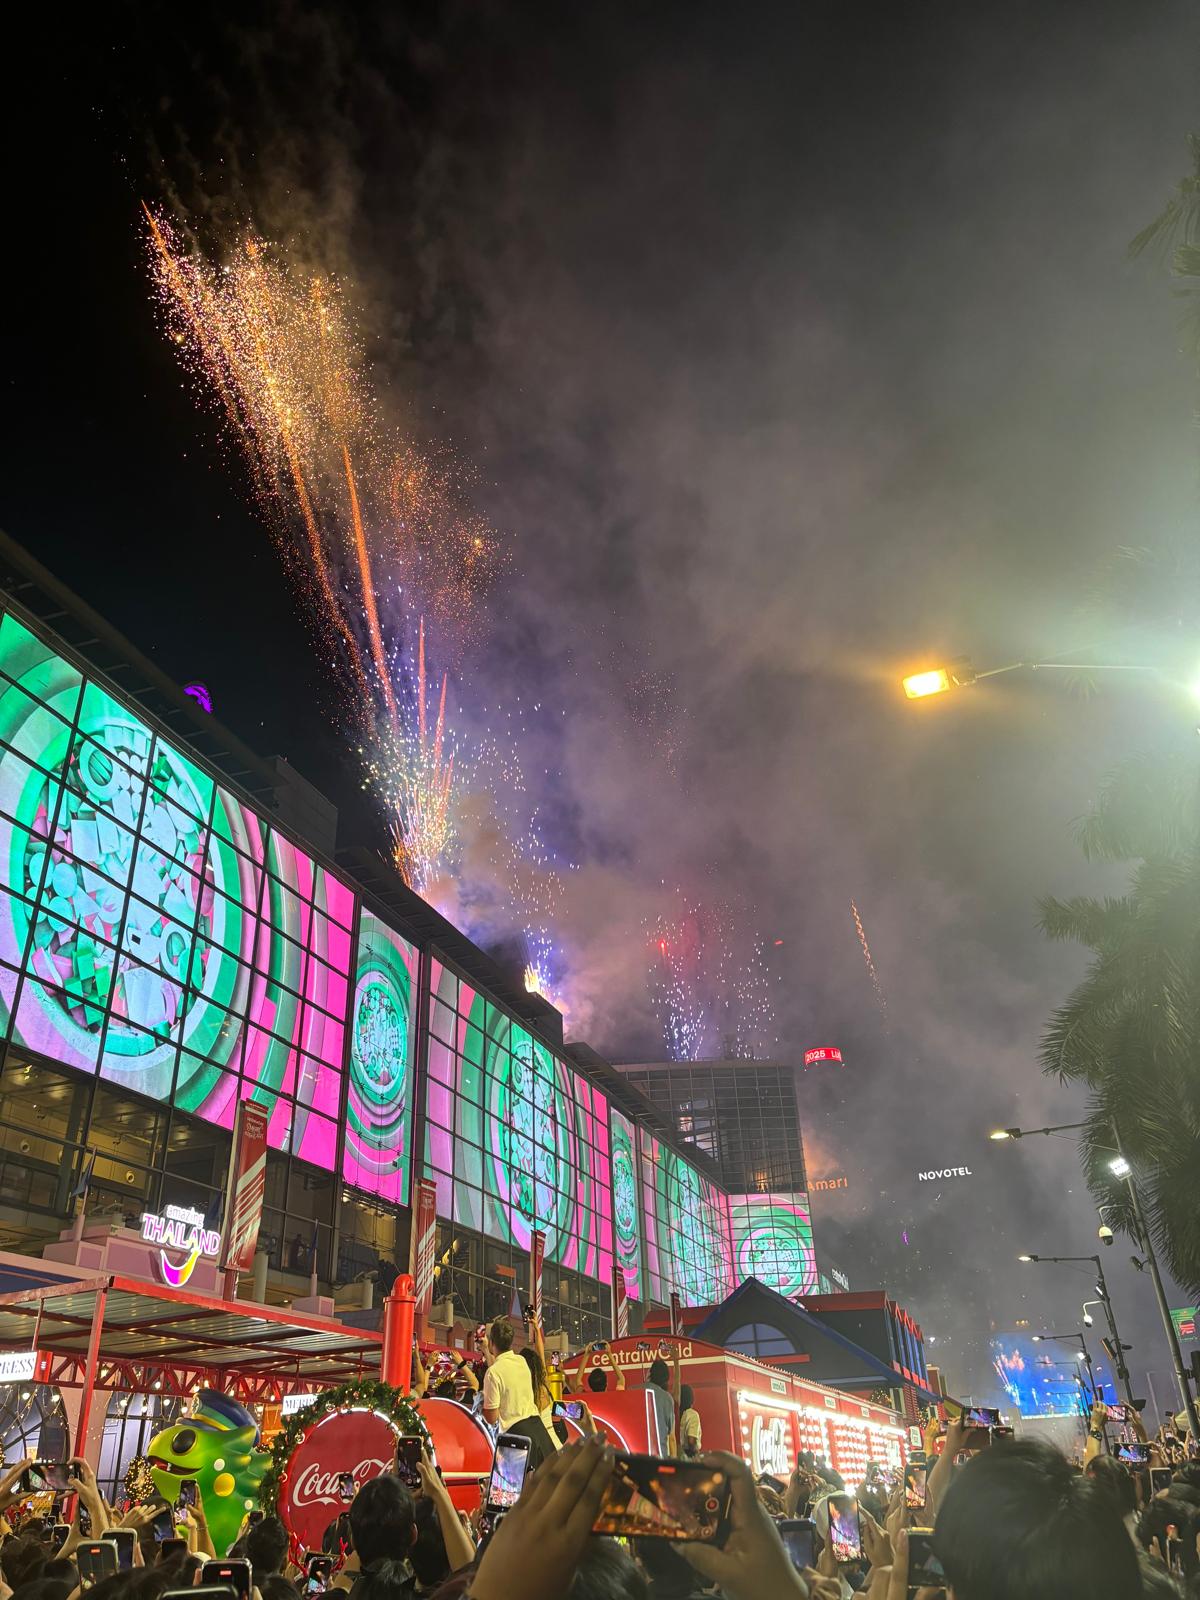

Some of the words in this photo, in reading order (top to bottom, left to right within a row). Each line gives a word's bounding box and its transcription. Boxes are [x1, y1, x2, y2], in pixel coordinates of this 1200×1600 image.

[806, 1050, 826, 1062] 2025
[918, 1166, 972, 1181] NOVOTEL
[167, 1204, 204, 1229] amazing
[143, 1213, 221, 1255] THAILAND
[0, 1357, 35, 1375] RESS
